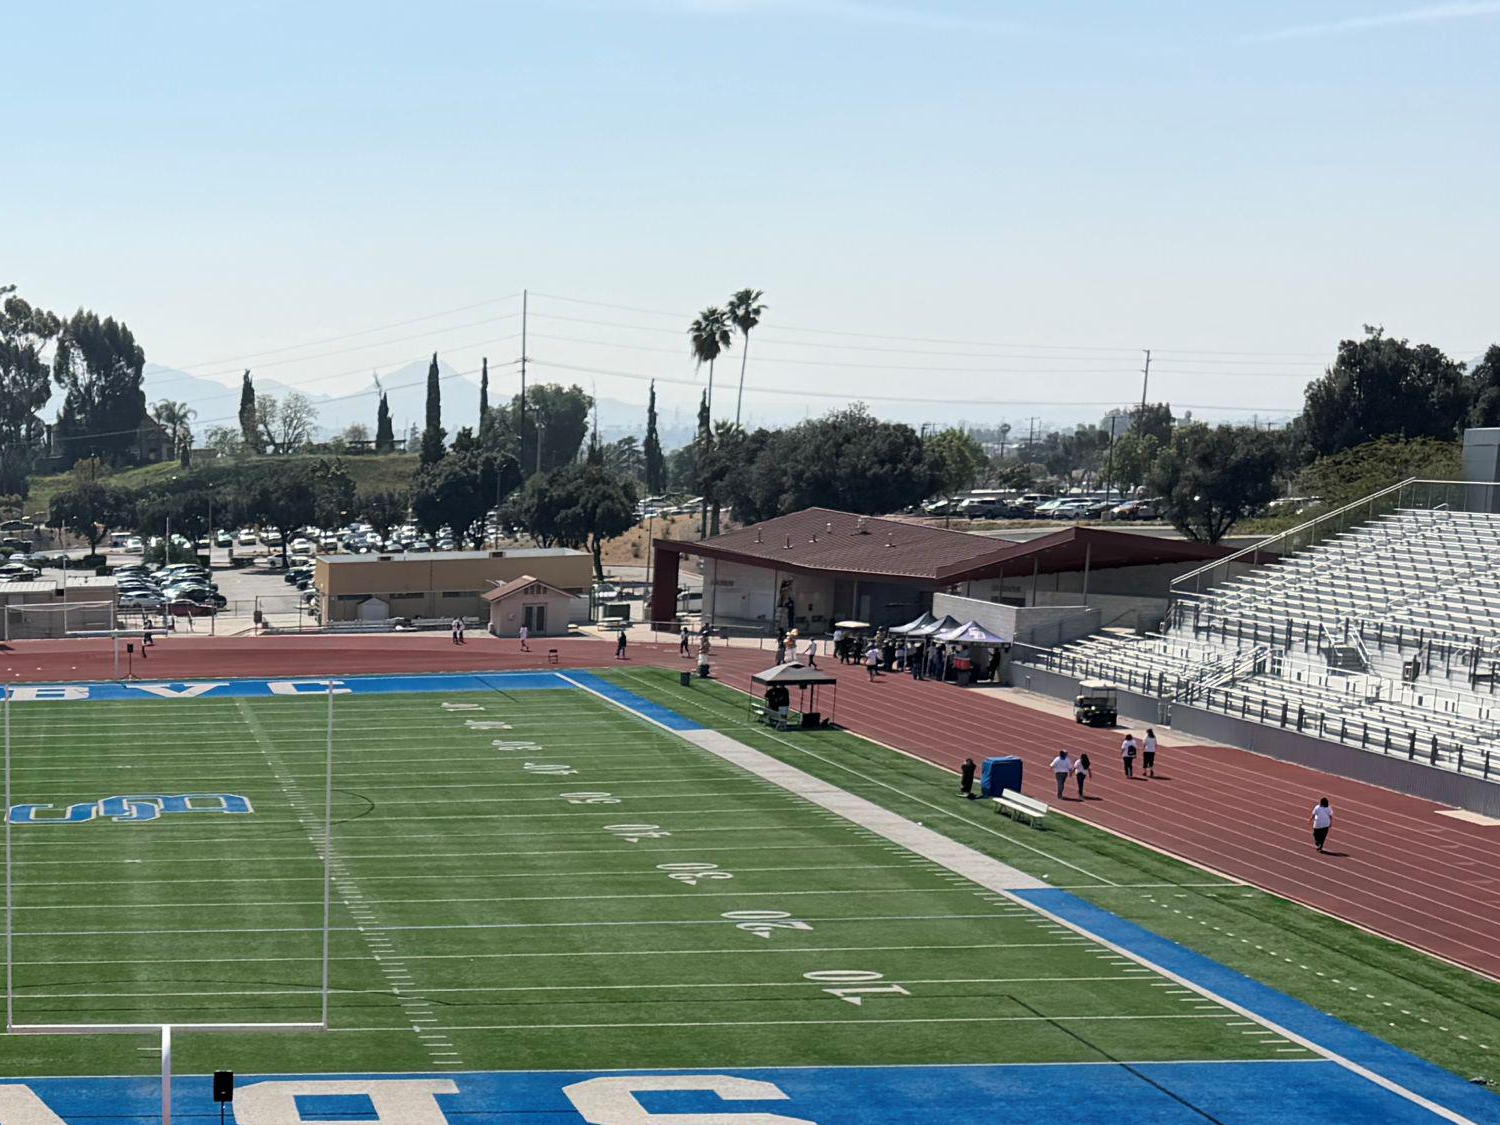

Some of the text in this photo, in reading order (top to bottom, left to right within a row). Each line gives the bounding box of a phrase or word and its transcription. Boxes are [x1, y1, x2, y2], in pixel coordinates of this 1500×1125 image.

[656, 862, 734, 880] 30
[720, 910, 814, 933] 20
[802, 969, 912, 997] 10
